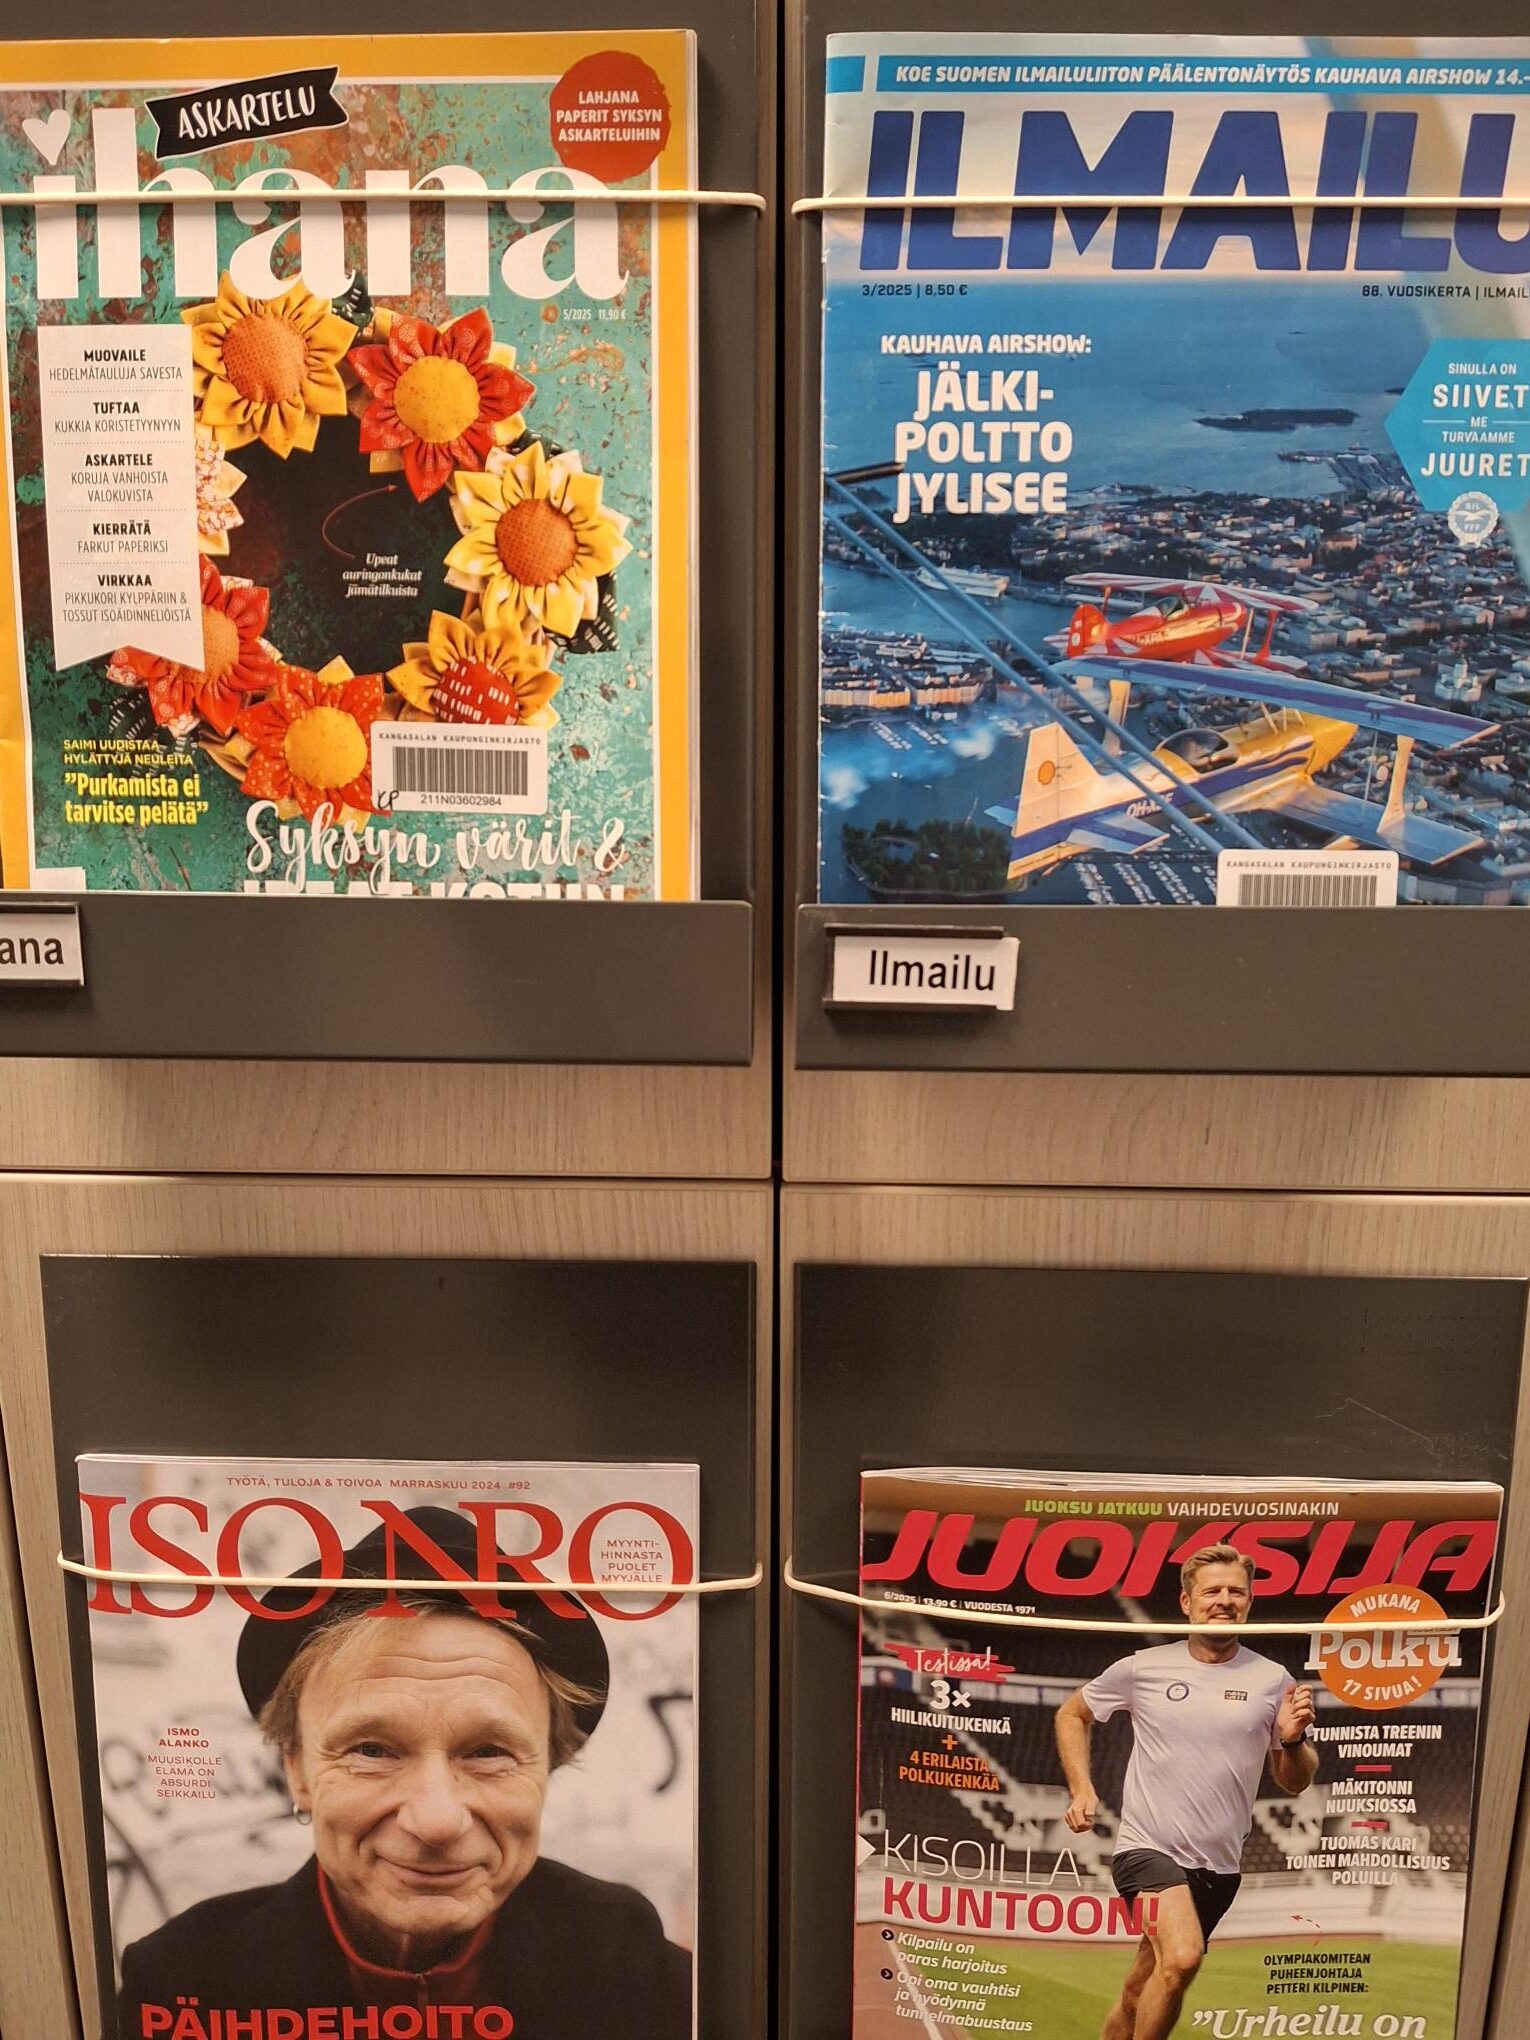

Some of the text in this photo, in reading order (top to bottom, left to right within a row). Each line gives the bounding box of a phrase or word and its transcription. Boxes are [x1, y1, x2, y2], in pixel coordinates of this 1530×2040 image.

[895, 65, 930, 82] KOE
[935, 65, 1011, 83] SUOMEN
[1015, 66, 1144, 83] ILMAILULIITON
[1147, 64, 1311, 84] PÄÄLENTONÄYTÖS
[1314, 67, 1402, 84] KAUHAVA
[1405, 68, 1492, 85] AIRSHOW
[579, 90, 639, 105] LAHJANA
[179, 85, 315, 139] ASKARTELU
[556, 108, 662, 123] PAPERIT SYKSYN
[558, 127, 660, 142] ASKARTELUIHIN
[860, 110, 1530, 274] ILMAILU
[22, 108, 628, 301] ihana
[862, 283, 912, 297] 3/2025
[959, 283, 968, 296] €
[1362, 285, 1383, 297] 88.
[1387, 285, 1471, 298] VUOSIKERTA
[563, 308, 592, 321] 5/2025
[881, 333, 1092, 354] KAUHAVA AIRSHOW:
[84, 349, 146, 362] MUOVAILE
[49, 366, 182, 381] HEDELMÄTAULUJA SAVESTA
[1448, 363, 1517, 375] SINULLA ON
[913, 360, 1055, 422] JÄLKI-
[1432, 383, 1530, 409] SIIVET
[93, 401, 140, 414] TUFTAA
[55, 418, 181, 433] KUKKIA KORISTETYYNYYN
[1471, 416, 1488, 428] ME
[895, 420, 1073, 464] POLTTO
[1442, 431, 1516, 443] TURVAAMME
[85, 453, 153, 467] ASKARTELE
[1420, 452, 1530, 477] JUURET
[71, 471, 168, 485] KORUJA VANHOISTA
[87, 488, 153, 502] VALOKUVISTA
[892, 471, 1068, 524] JYLISEE
[93, 520, 151, 535] KIERRÄTÄ
[77, 540, 168, 553] FARKUT PAPERIKSI
[366, 553, 398, 567] Upeat
[97, 574, 152, 587] VIRKKAA
[342, 568, 422, 582] auringonkukat
[65, 591, 187, 605] PIKKUKORI KYLPPÄRIIN &
[345, 583, 418, 599] jämätilkuista
[62, 609, 97, 622] TOSSUT
[63, 739, 160, 751] SAIMI UUDISTAA
[379, 732, 542, 745] KANGASALAN KAUPUNGINKIRJASTO
[64, 753, 193, 765] HYLÄTTYJÄ NEULEITA
[183, 773, 200, 797] ei
[420, 794, 502, 806] 211N03602984
[65, 800, 135, 824] tarvitse
[245, 799, 626, 894] Syksyn värit &
[1226, 860, 1392, 870] KANGASALAN KAUPUNGINKIRJASTO
[0, 937, 64, 965] ana
[869, 949, 995, 991] Ilmailu
[226, 1475, 531, 1490] TYÖTÄ, TULOJA & TOIVOA MARRASKUU 2024 #92
[1024, 1499, 1339, 1517] JUOKSU JATKUU VAIHDEVUOSINAKIN
[607, 1539, 660, 1548] MYYNTI-
[601, 1551, 663, 1560] HINNASTA
[862, 1510, 1499, 1597] JUOKSIJA
[608, 1562, 656, 1571] PUOLET
[883, 1591, 916, 1604] 6/2025
[949, 1599, 957, 1608] €
[964, 1601, 1013, 1612] VUODESTA
[1014, 1605, 1036, 1614] 1971
[1350, 1593, 1421, 1618] MUKANA
[1304, 1629, 1462, 1670] Polku
[915, 1646, 991, 1674] Testissä!
[1343, 1679, 1362, 1696] 17
[891, 1707, 1011, 1734] HIILIKUITUKENKÄ
[167, 1727, 200, 1736] ISMO
[1313, 1725, 1442, 1742] TUNNISTA TREENIN
[158, 1739, 209, 1748] ALANKO
[942, 1735, 958, 1750] +
[1338, 1743, 1413, 1758] VINOUMAT
[147, 1754, 222, 1765] MUUSIKOLLE
[910, 1750, 989, 1772] 4 ERILAISTA
[197, 1768, 215, 1777] ON
[899, 1766, 999, 1791] POLKUKENKÄÄ
[160, 1778, 211, 1788] ABSURDI
[1332, 1778, 1413, 1796] MÄKITONNI
[157, 1789, 216, 1799] SEIKKAILU
[1326, 1798, 1417, 1814] NUUKSIOSSA
[1321, 1836, 1417, 1851] TUOMAS KARI
[884, 1828, 1082, 1887] KISOILLA
[1286, 1853, 1450, 1870] TOINEN MAHDOLLISUUS
[1332, 1871, 1399, 1885] POLUILLA
[883, 1876, 1160, 1937] KUNTOON!
[897, 1931, 975, 1955] Kilpailu on
[897, 1951, 1008, 1975] paras harjoitus
[1263, 1953, 1371, 1966] OLYMPIAKOMITEAN
[1270, 1968, 1362, 1980] PUHEENJOHTAJA
[896, 1970, 1021, 1998] Opi oma vauhtisi
[1266, 1982, 1369, 1994] PETTERI KILPINEN:
[894, 1987, 910, 2001] ja
[140, 1996, 514, 2040] PÄIHDEHOITO
[1373, 2012, 1426, 2039] on
